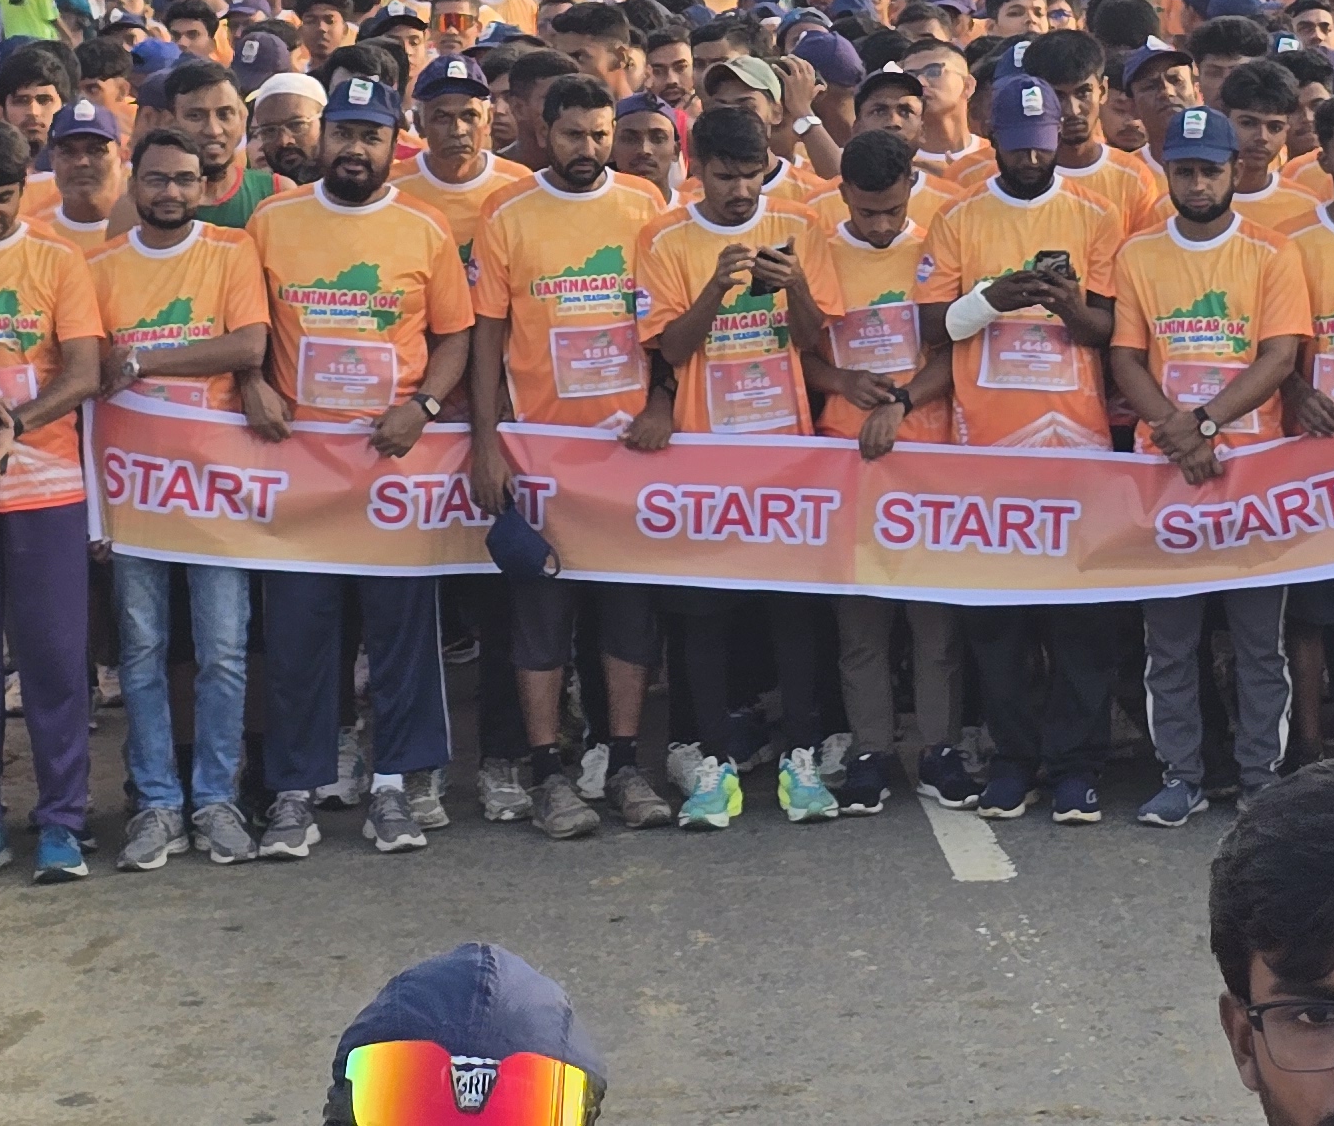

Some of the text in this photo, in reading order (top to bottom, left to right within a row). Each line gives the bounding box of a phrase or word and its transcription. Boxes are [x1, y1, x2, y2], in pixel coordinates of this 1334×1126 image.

[536, 276, 635, 296] RANINAGAR 10
[284, 289, 400, 309] RANINAGAR 10K
[188, 324, 211, 337] 10K
[714, 312, 767, 331] INAGAR
[106, 450, 283, 522] START
[370, 476, 552, 528] STAT
[641, 487, 838, 542] START
[880, 495, 1079, 552] START
